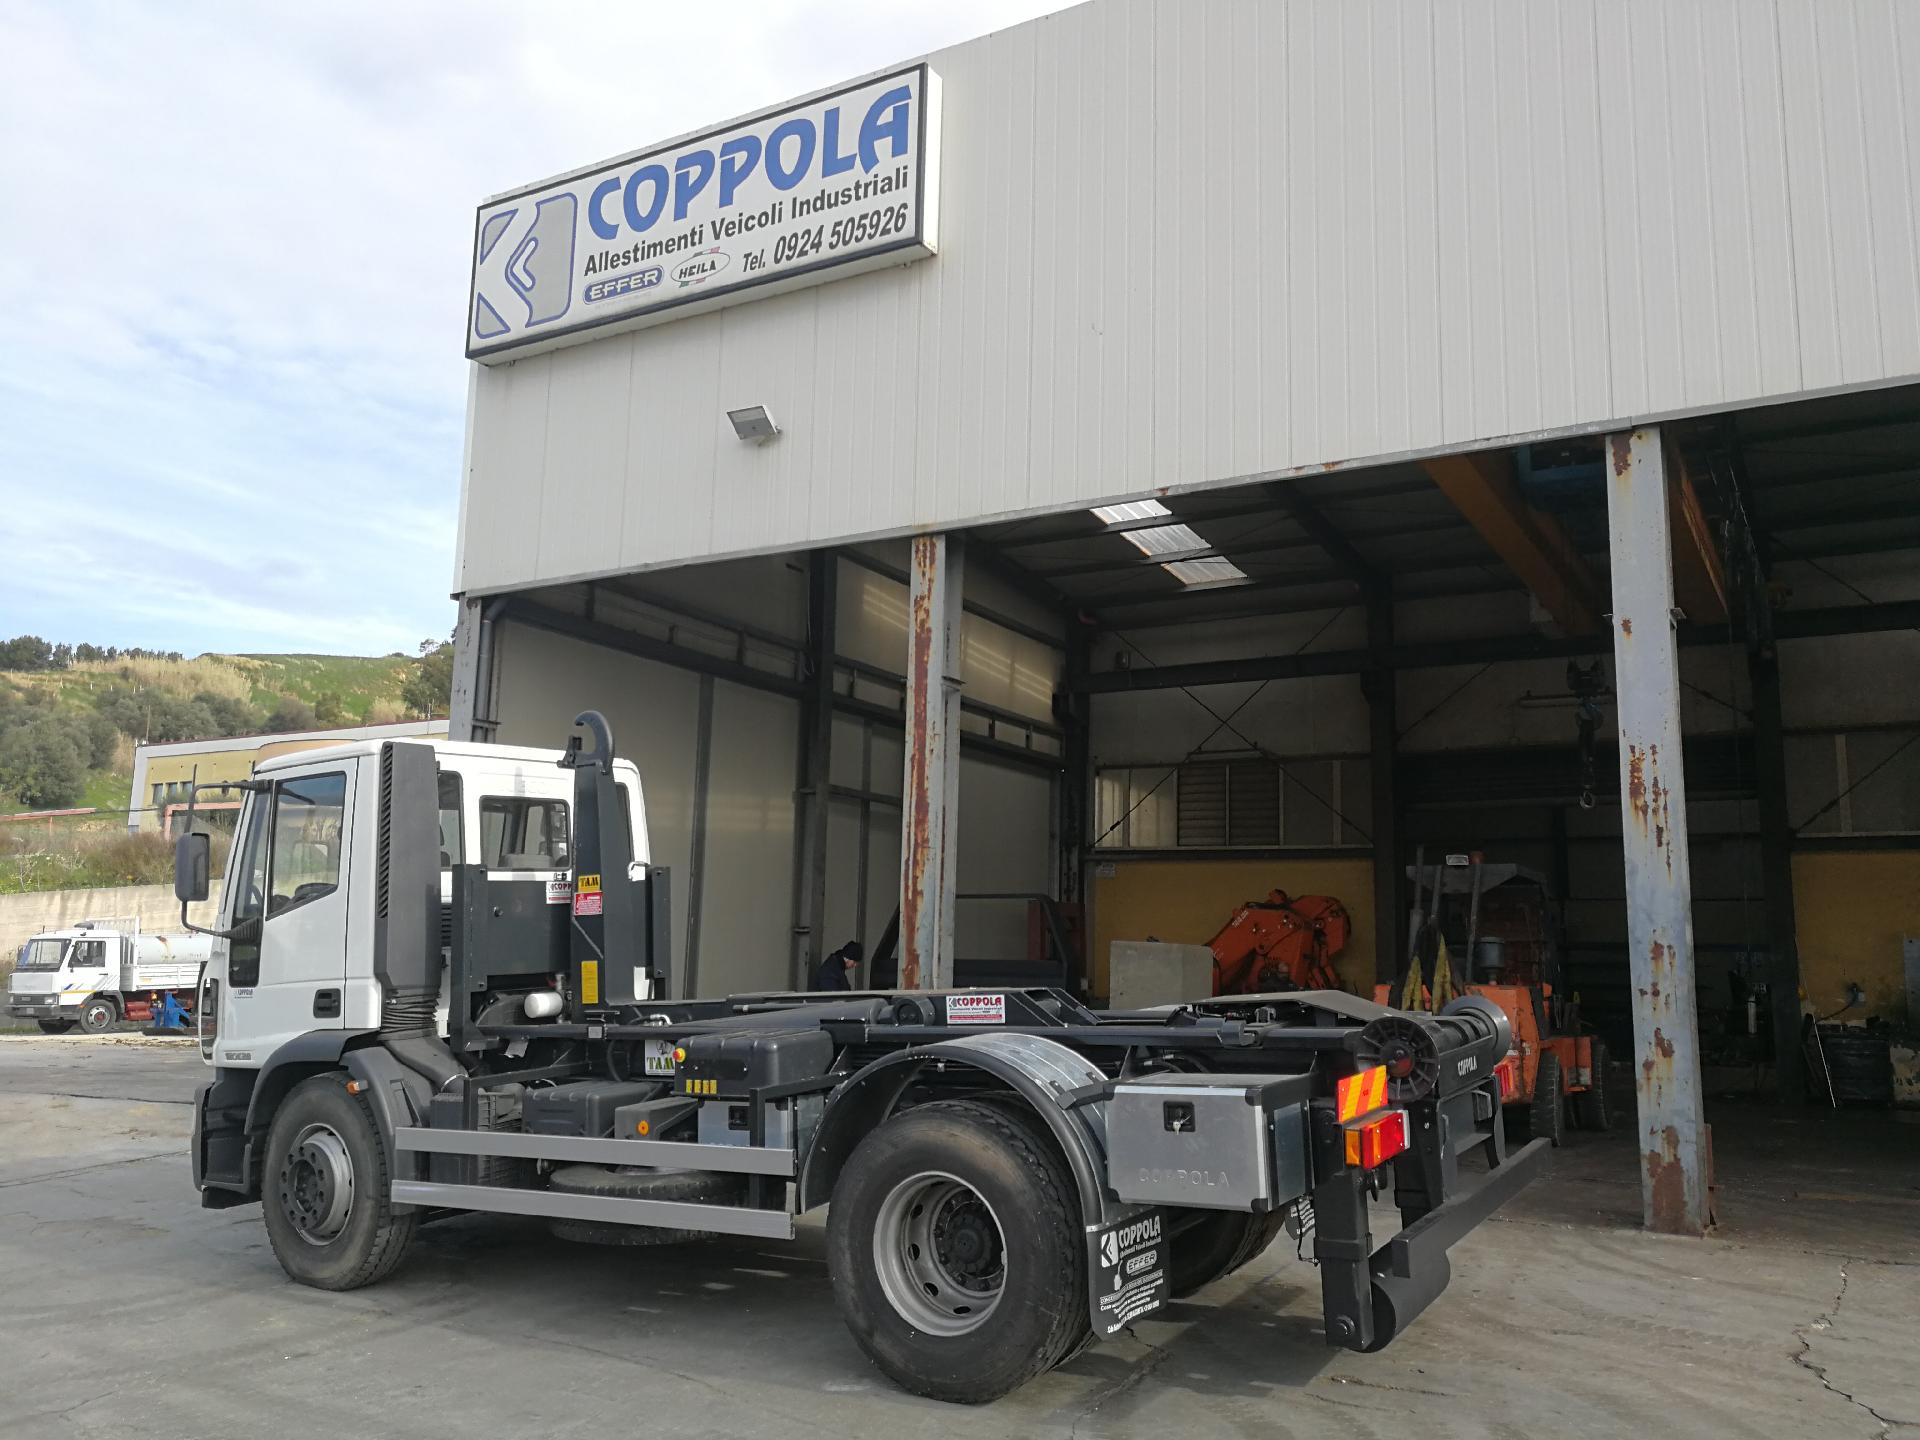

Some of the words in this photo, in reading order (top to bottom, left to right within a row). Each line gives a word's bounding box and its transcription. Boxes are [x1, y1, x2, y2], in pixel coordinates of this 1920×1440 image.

[588, 85, 912, 239] COPPOLA
[584, 229, 704, 276] Allestimenti
[711, 201, 783, 240] Veicoli
[791, 166, 908, 220] Industriali
[743, 249, 766, 273] Tel.
[773, 230, 824, 264] 0924
[828, 204, 908, 251] 505926
[679, 260, 717, 279] HEILA
[590, 270, 658, 299] EFFER
[957, 996, 1002, 1006] COPPOLA
[647, 1056, 675, 1070] TAM
[1118, 1216, 1161, 1249] COPPOLA
[1128, 1253, 1156, 1271] EFFER
